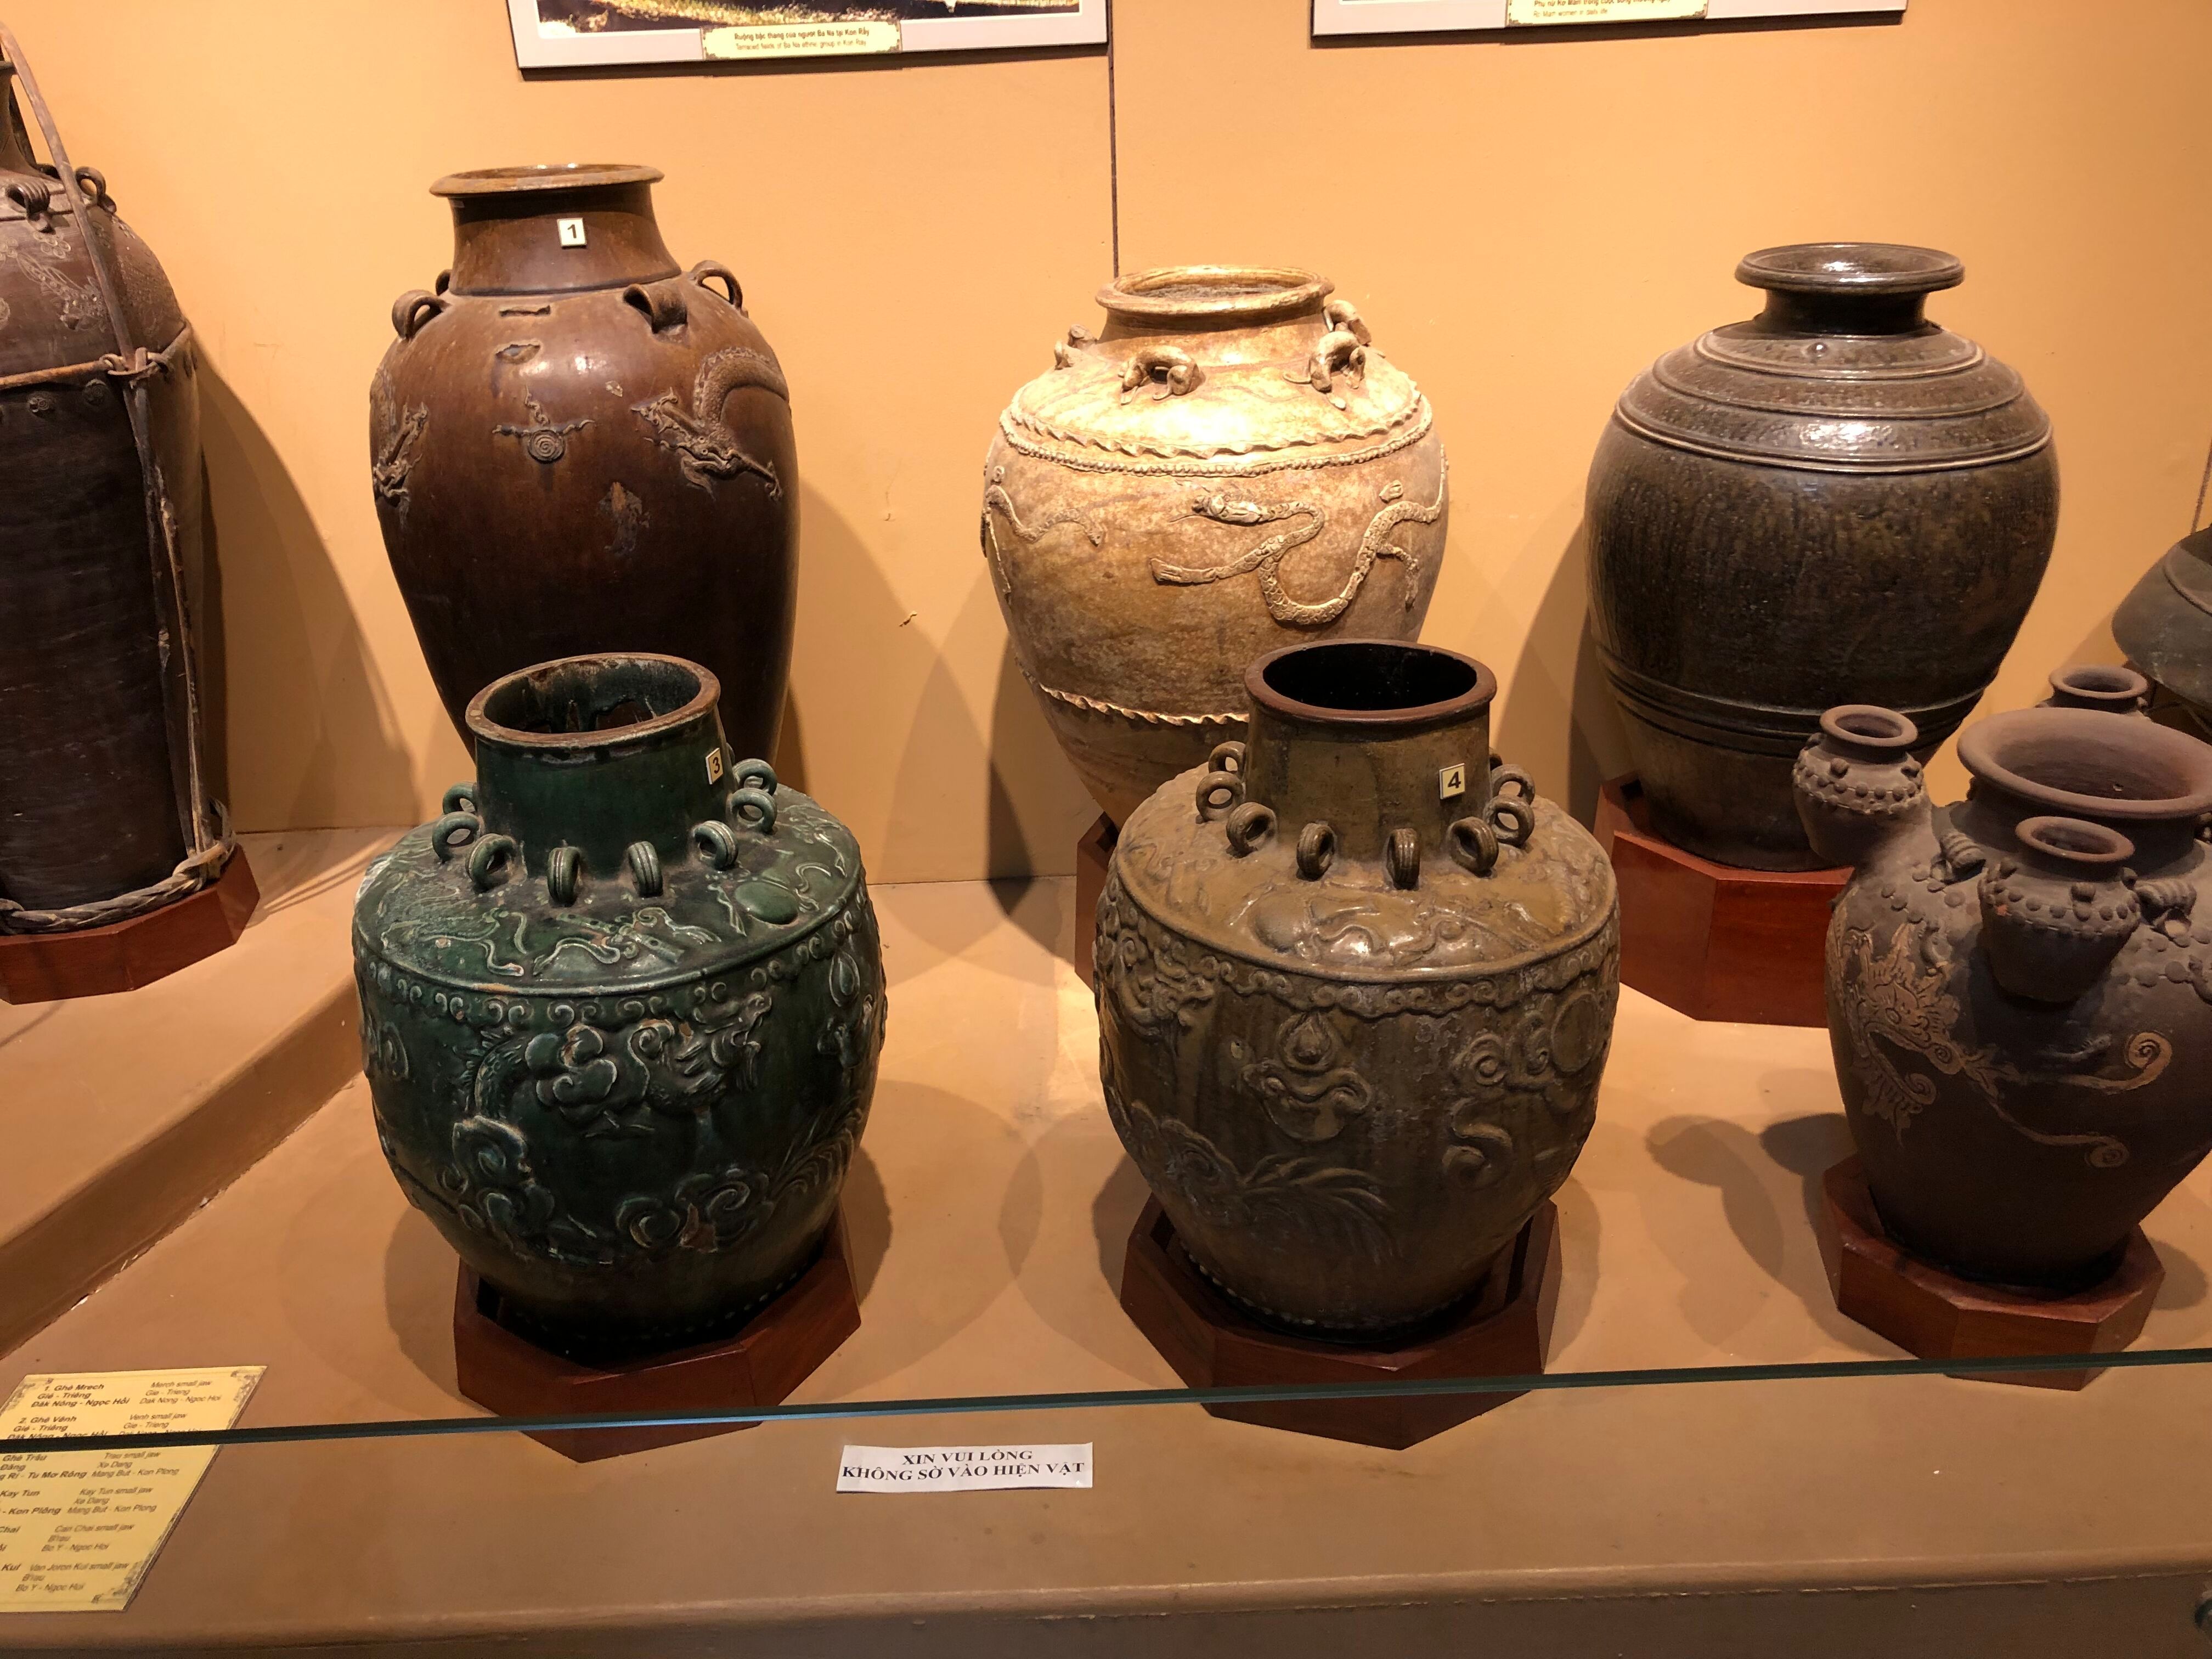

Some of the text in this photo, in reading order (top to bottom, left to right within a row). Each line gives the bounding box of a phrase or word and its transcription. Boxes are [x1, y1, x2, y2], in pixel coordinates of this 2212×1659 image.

[567, 224, 577, 239] 1
[713, 757, 720, 774] 3
[1448, 771, 1461, 788] 4
[902, 1449, 1032, 1465] XIN VUI LÒNG
[842, 1462, 1085, 1481] KHÔNG SỜ VÀO HIỆN VẬT
[133, 1504, 157, 1513] Plong
[70, 1543, 93, 1552] Ngoc
[89, 1562, 114, 1570] small
[44, 1584, 67, 1593] Ngoc
